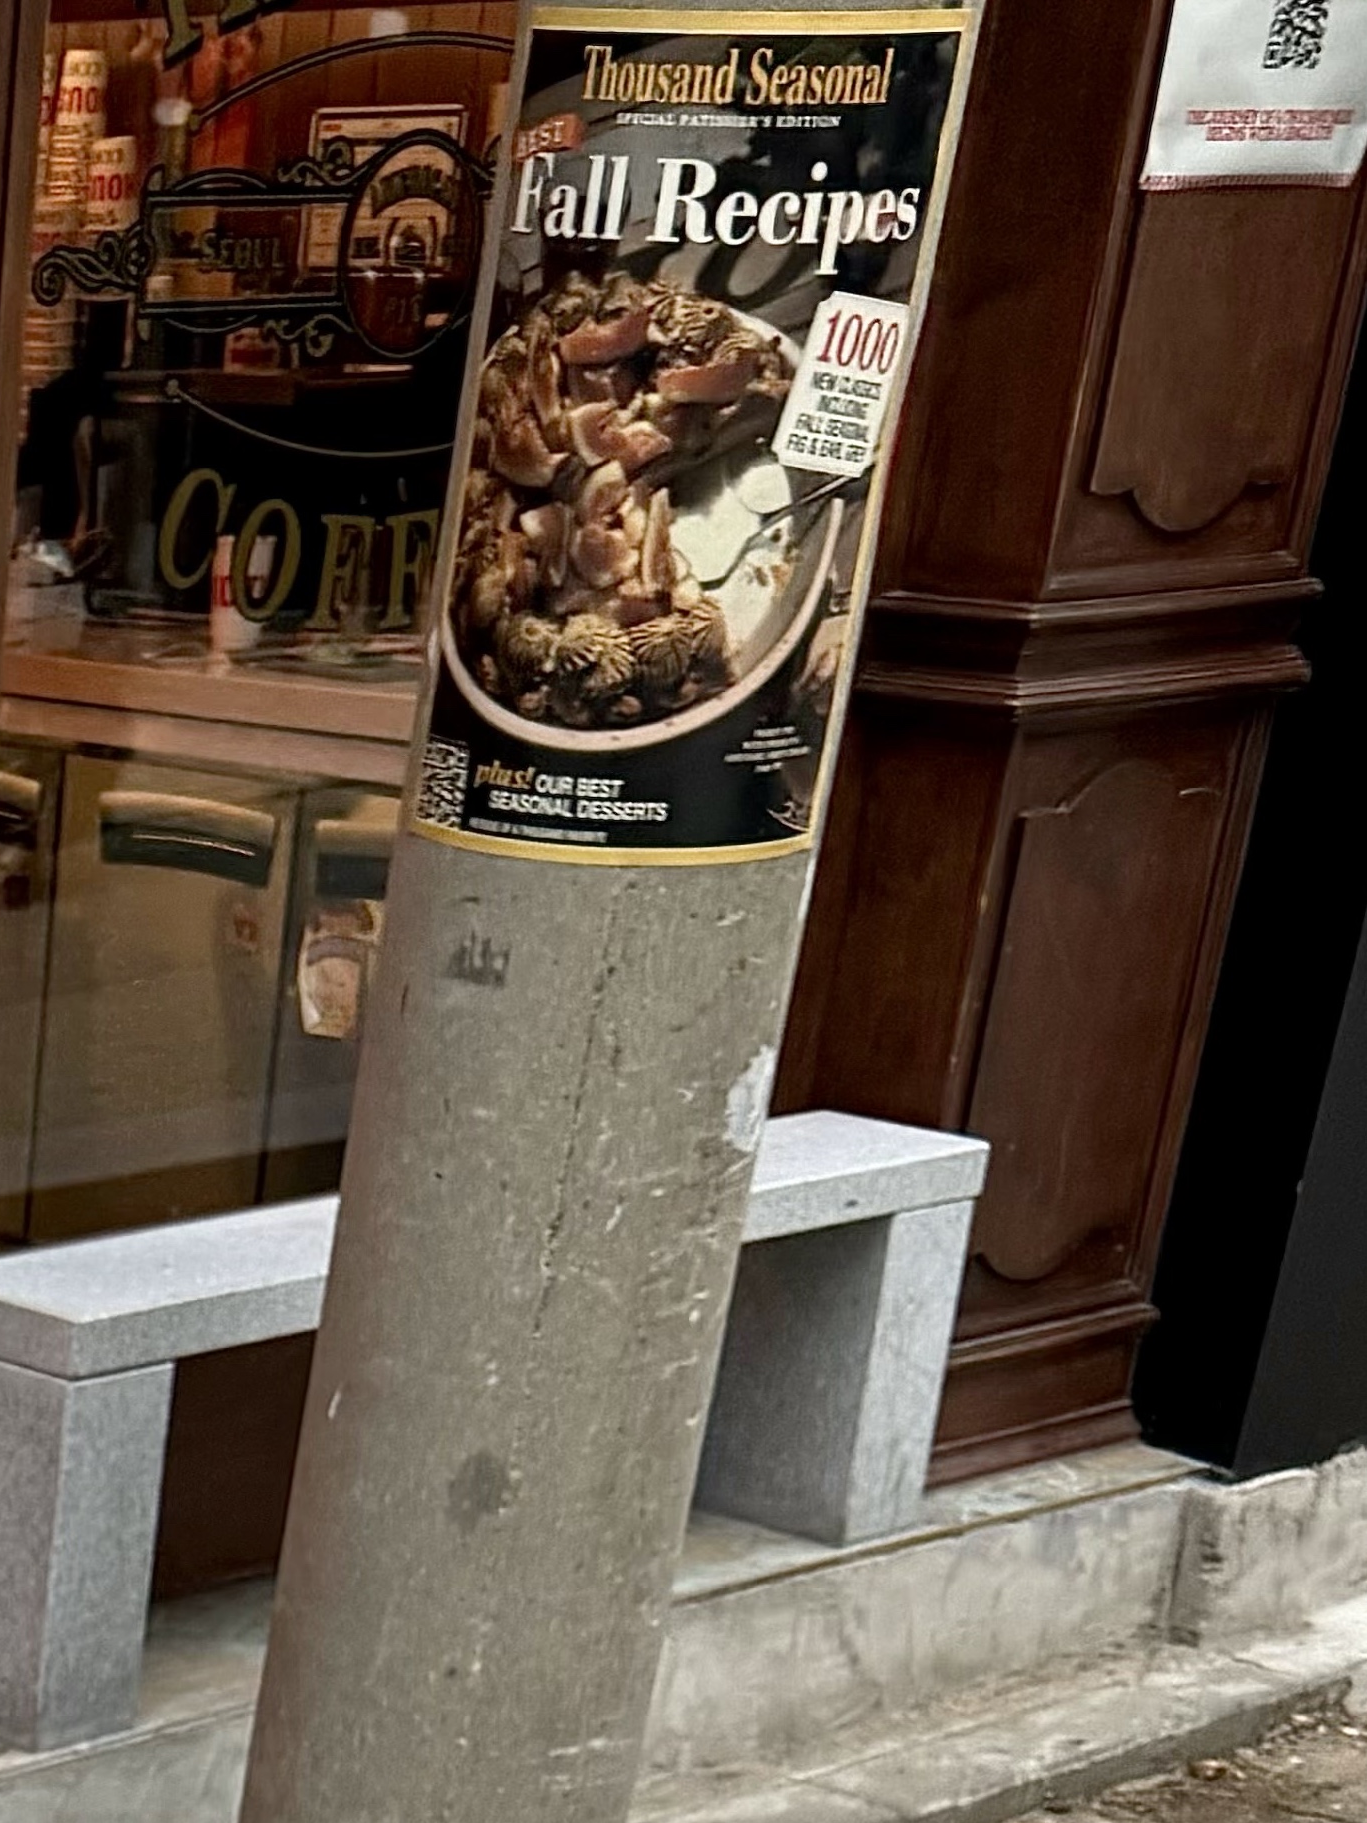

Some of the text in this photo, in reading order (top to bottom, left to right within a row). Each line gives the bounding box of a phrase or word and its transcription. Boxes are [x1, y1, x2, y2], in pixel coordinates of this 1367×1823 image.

[582, 45, 895, 106] Thousand Seasonal
[510, 152, 629, 240] Fall
[645, 157, 921, 277] Recipes
[817, 310, 899, 374] 1000
[474, 761, 534, 789] plus!
[577, 776, 626, 799] BEST
